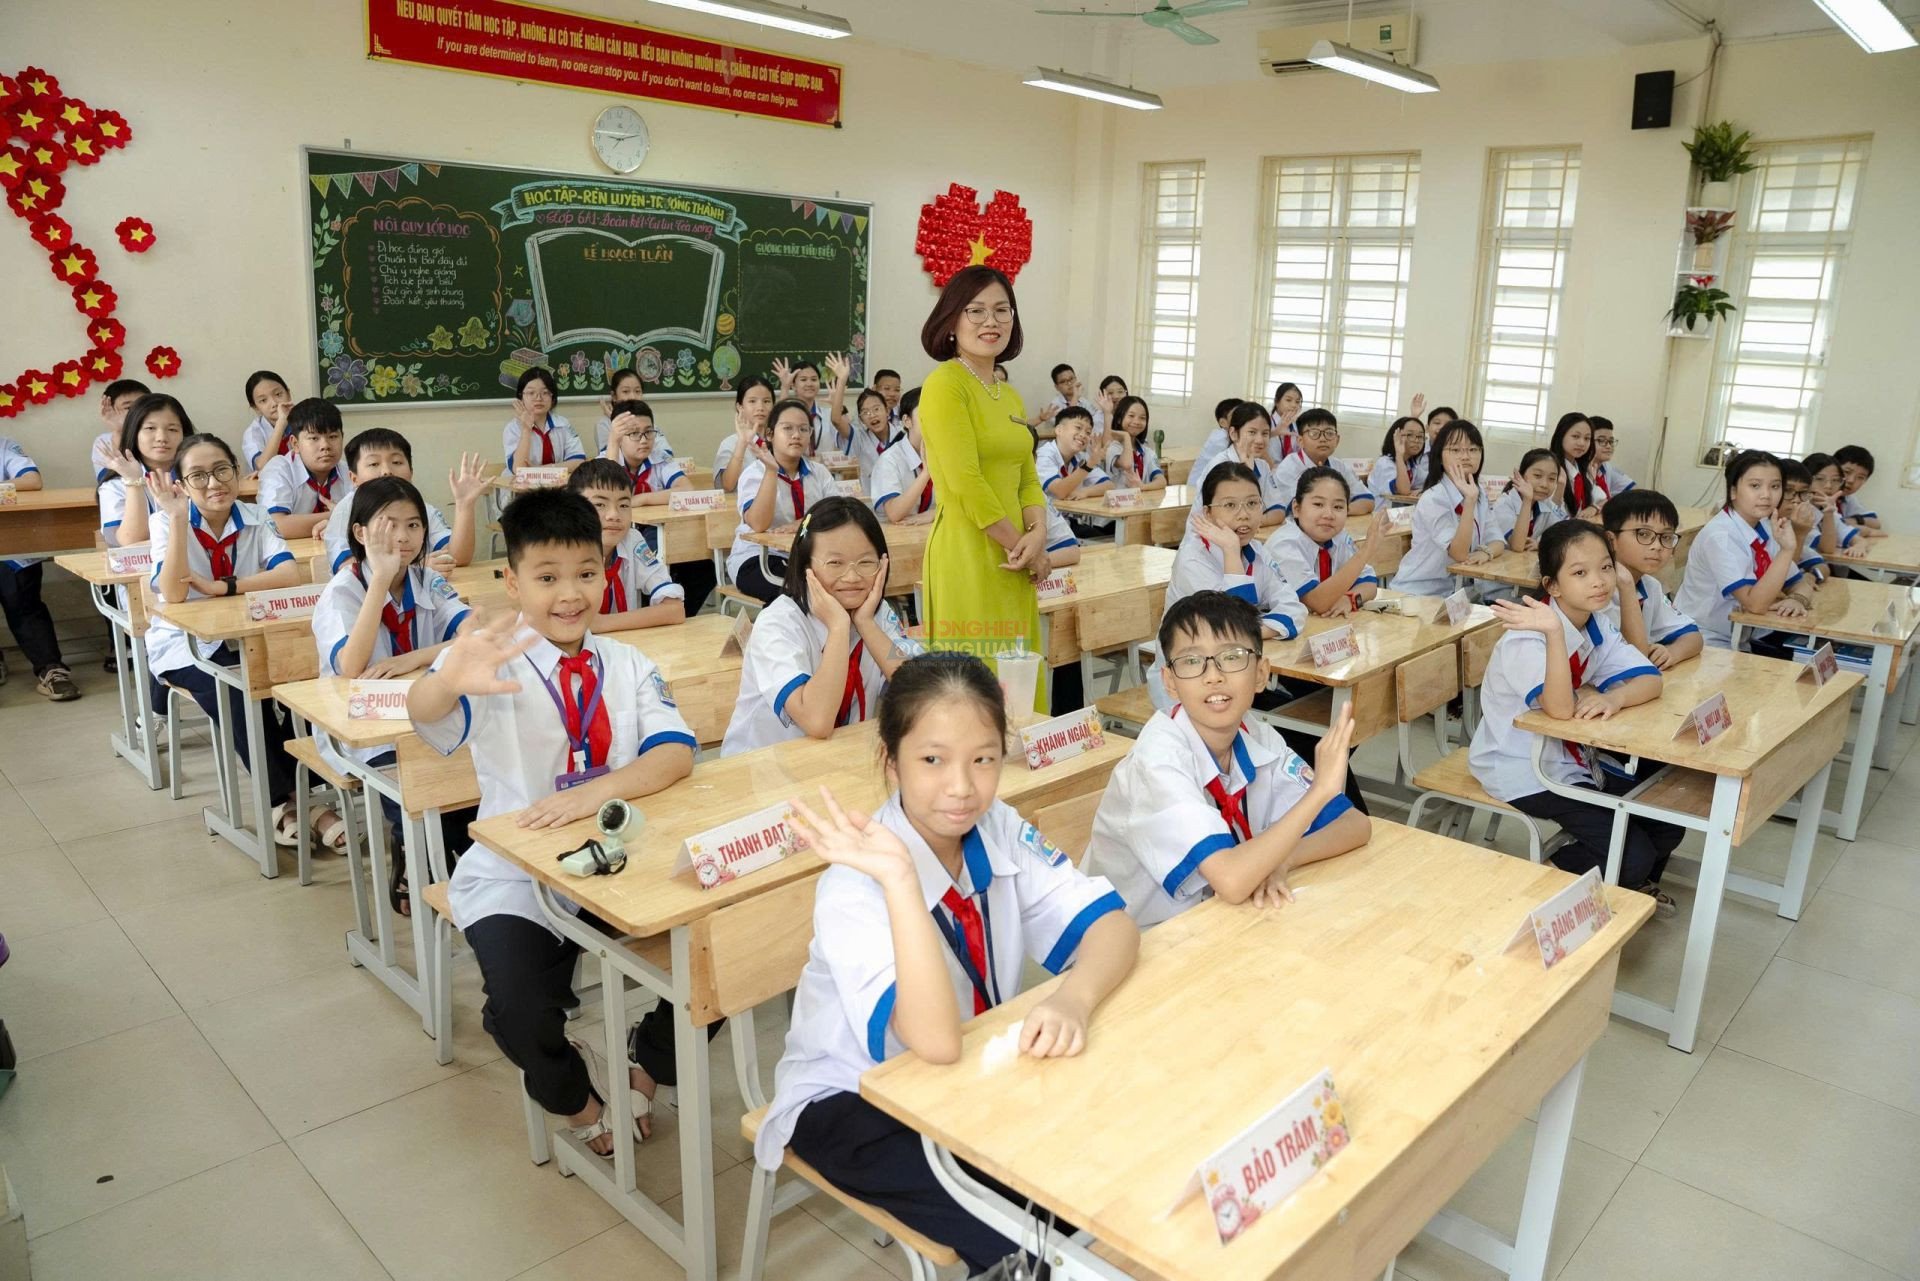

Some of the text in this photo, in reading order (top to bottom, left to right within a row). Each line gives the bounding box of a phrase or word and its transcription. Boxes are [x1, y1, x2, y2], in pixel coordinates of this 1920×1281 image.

[416, 3, 434, 25] BẠN
[437, 4, 462, 27] QUYẾT
[464, 10, 482, 31] TÂM
[484, 16, 500, 38] HỌC
[520, 21, 547, 42] KHÔNG
[548, 28, 556, 44] AI
[558, 27, 568, 46] CÓ
[584, 32, 605, 52] NGĂN
[656, 46, 670, 66] BẠN
[671, 49, 694, 68] KHÔNG
[752, 66, 758, 80] AI
[437, 36, 444, 49] If
[445, 41, 462, 54] you
[464, 44, 478, 55] are
[480, 44, 526, 62] determined
[528, 53, 536, 64] to
[537, 54, 560, 70] learn,
[561, 59, 572, 70] no
[574, 62, 588, 72] one
[589, 64, 603, 75] can
[604, 65, 622, 80] stop
[624, 70, 640, 82] you.
[642, 70, 649, 82] If
[649, 74, 662, 86] you
[664, 74, 684, 88] don't
[685, 79, 702, 92] want
[704, 82, 712, 92] to
[712, 83, 732, 98] learn,
[732, 88, 742, 98] no
[743, 90, 756, 100] one
[757, 92, 770, 102] can
[770, 92, 785, 108] help
[524, 189, 552, 208] HỌC
[692, 203, 724, 221] THÀNH
[374, 216, 471, 238] NỘI QUY LỚP HỌC
[388, 241, 405, 254] học
[408, 242, 428, 258] đúng
[442, 287, 464, 300] chung
[269, 599, 288, 610] THU
[1036, 722, 1090, 754] KHÁNH NGÂN
[718, 823, 788, 865] THÀNH ĐẠT
[1552, 896, 1597, 941] ĐĂNG MINH
[1242, 1115, 1319, 1195] BẢO TRÂM
